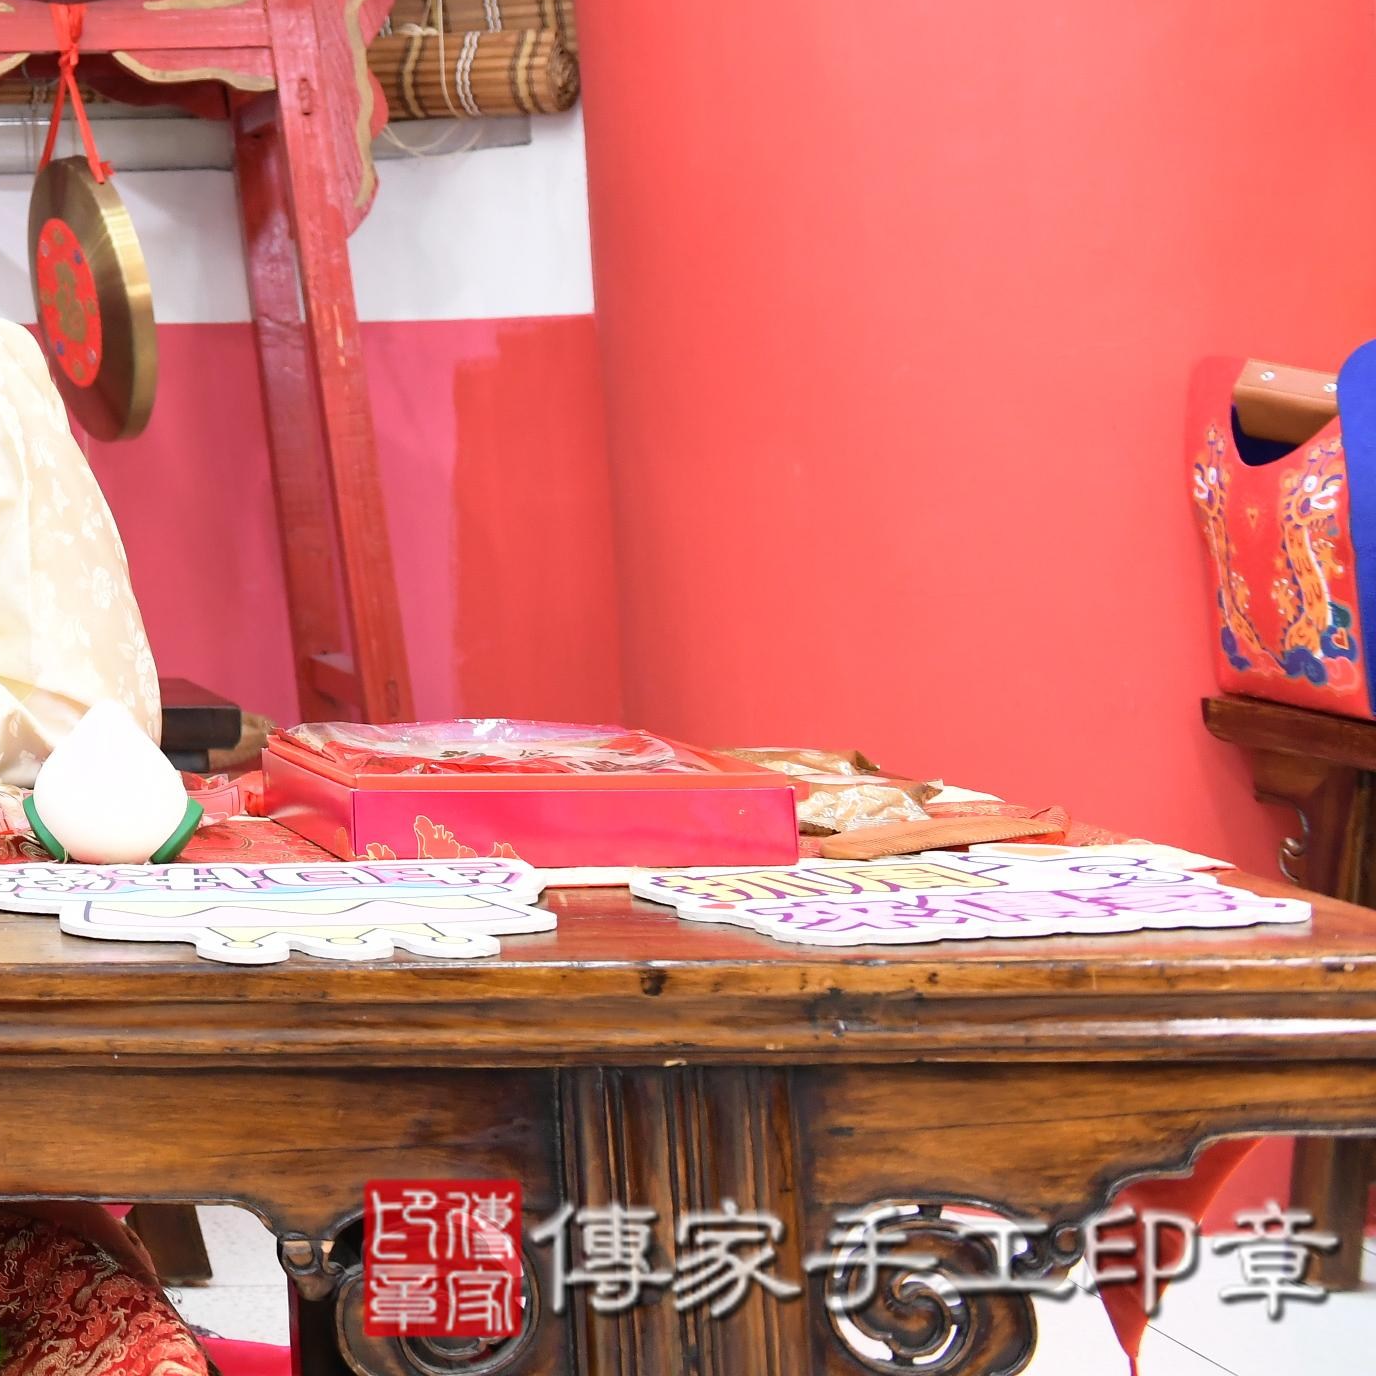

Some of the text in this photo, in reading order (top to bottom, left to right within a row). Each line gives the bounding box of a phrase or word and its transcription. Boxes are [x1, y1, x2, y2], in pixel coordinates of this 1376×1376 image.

[650, 862, 1010, 902] 抓周
[746, 885, 1287, 932] 來傳家
